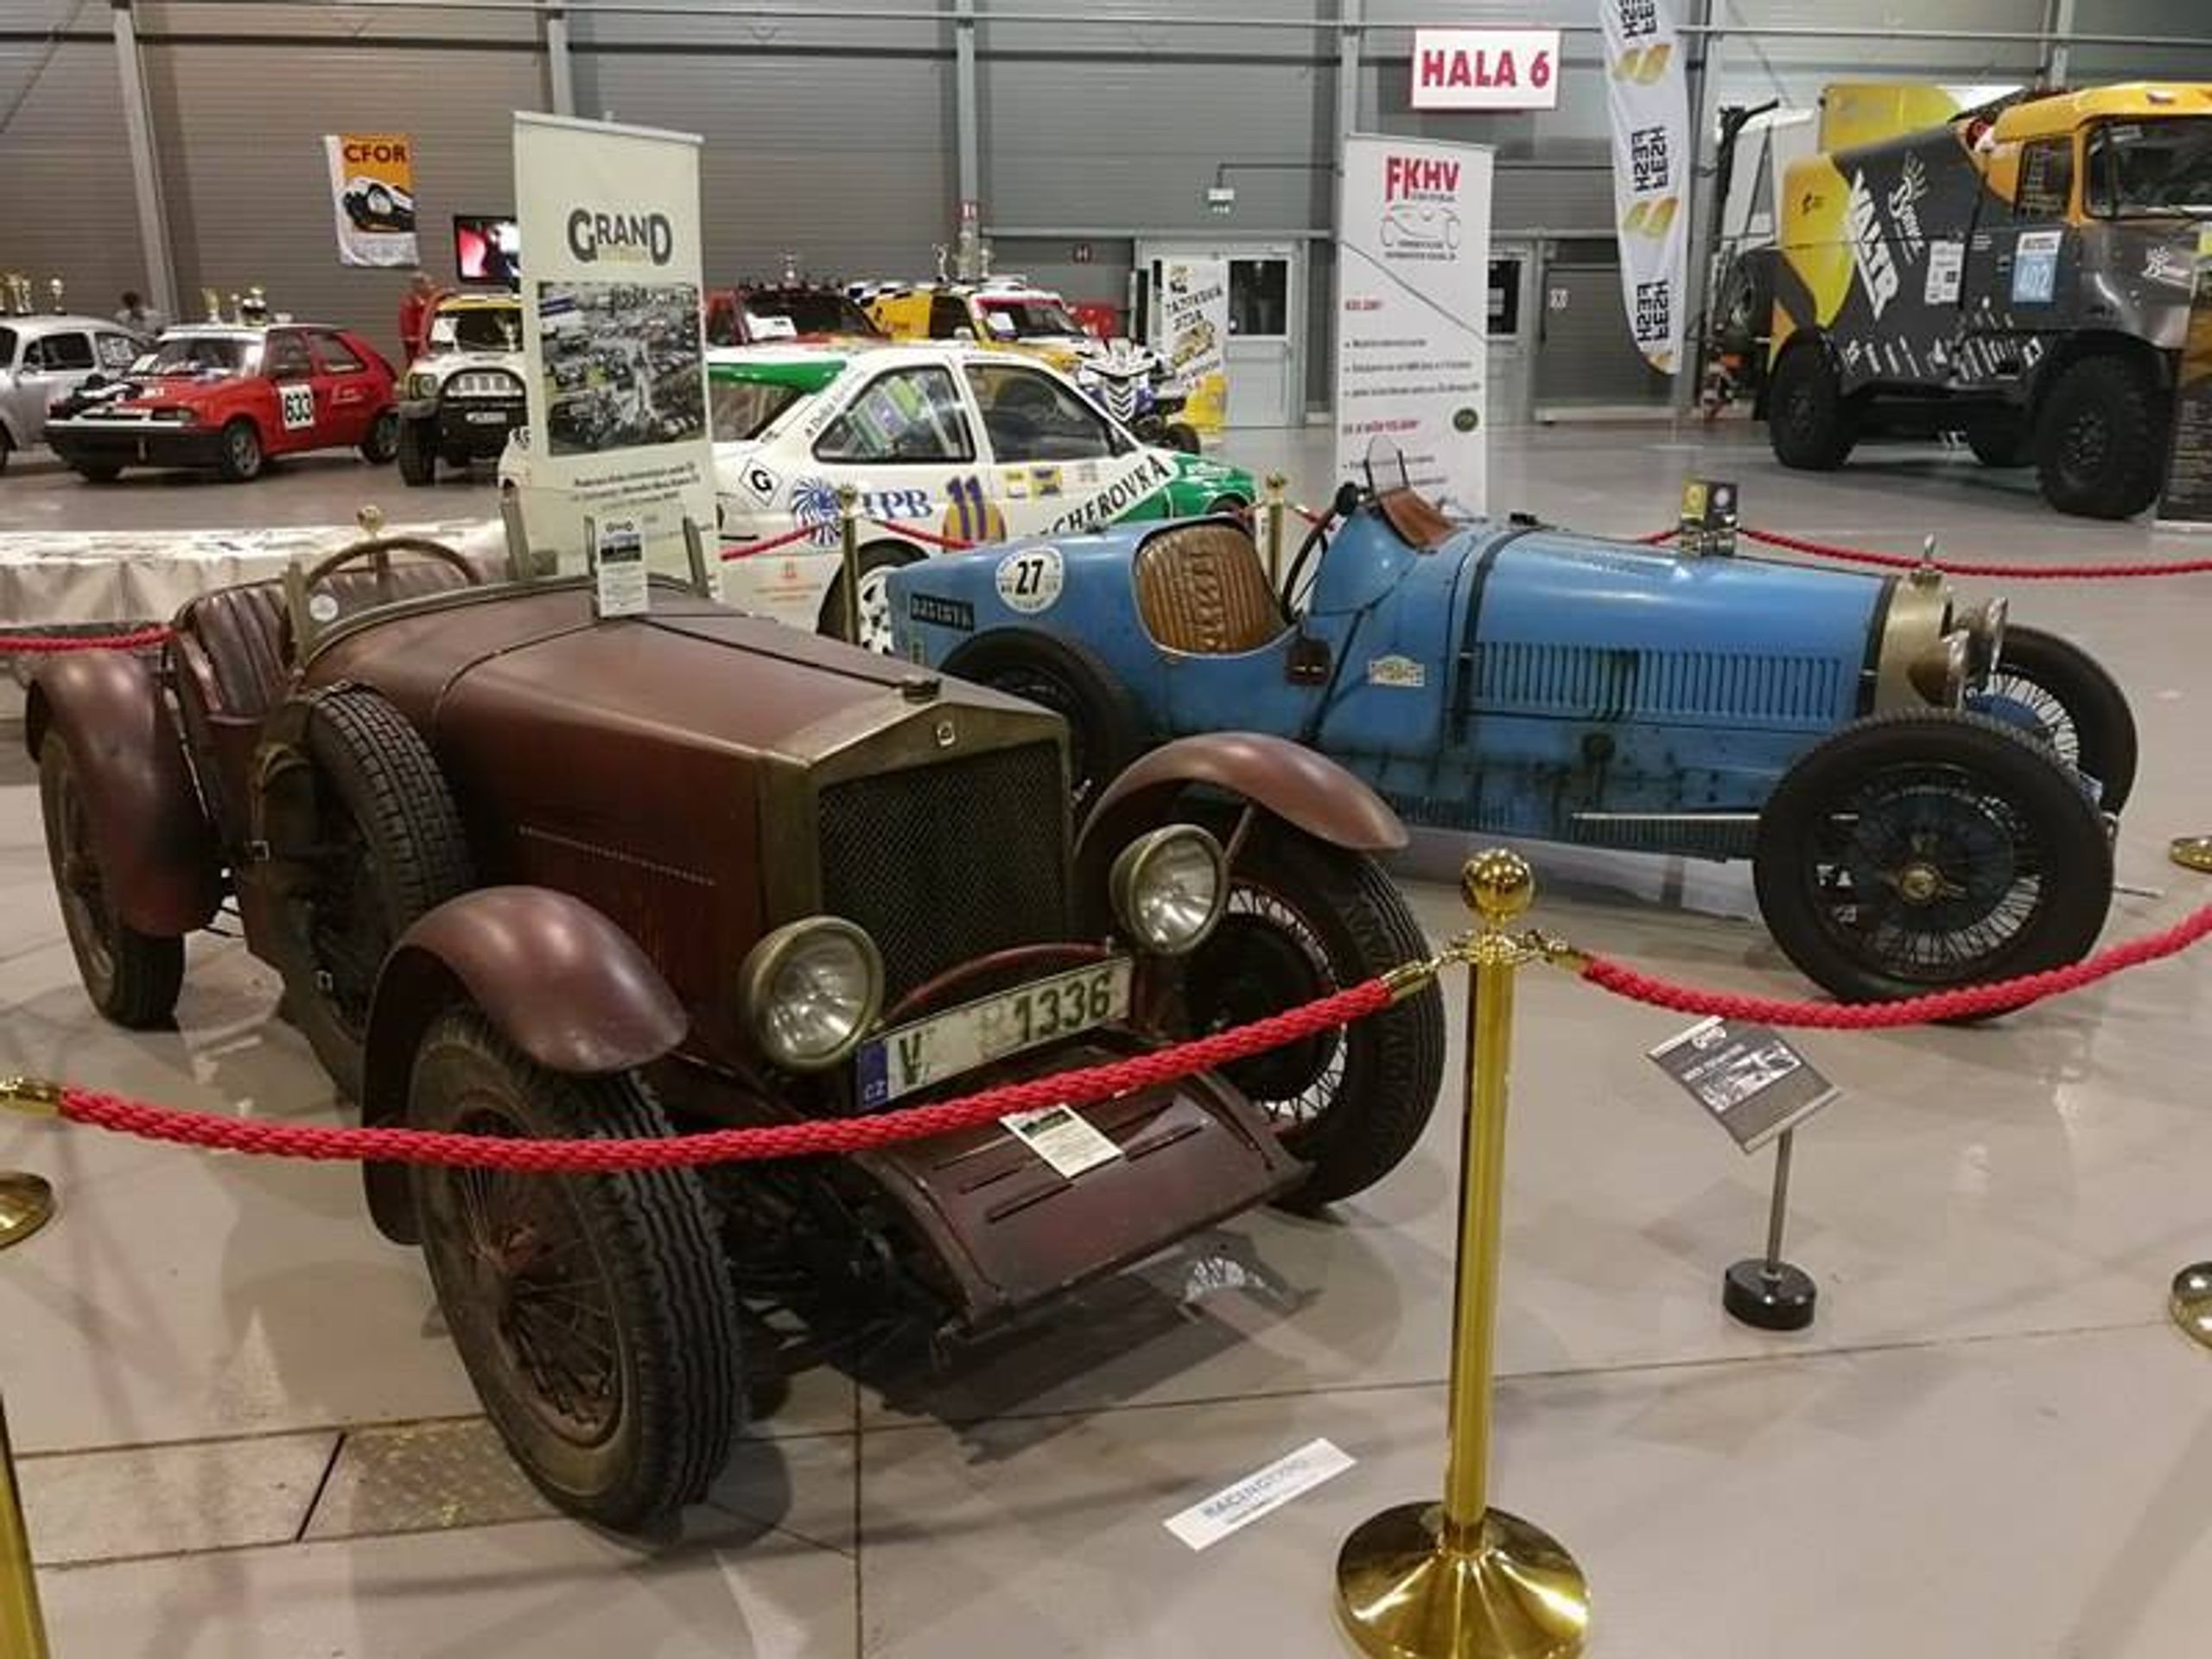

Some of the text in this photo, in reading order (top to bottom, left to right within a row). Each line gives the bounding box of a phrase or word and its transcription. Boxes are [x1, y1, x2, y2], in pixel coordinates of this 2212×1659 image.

[1421, 49, 1550, 89] HALA 6
[344, 143, 406, 162] CFOR
[1385, 155, 1460, 201] FKHV
[567, 208, 673, 266] GRAND
[751, 468, 773, 493] G
[1039, 453, 1171, 535] CHEROVKA
[946, 474, 987, 542] 11
[1014, 559, 1044, 595] 27
[1014, 974, 1111, 1043] 1336
